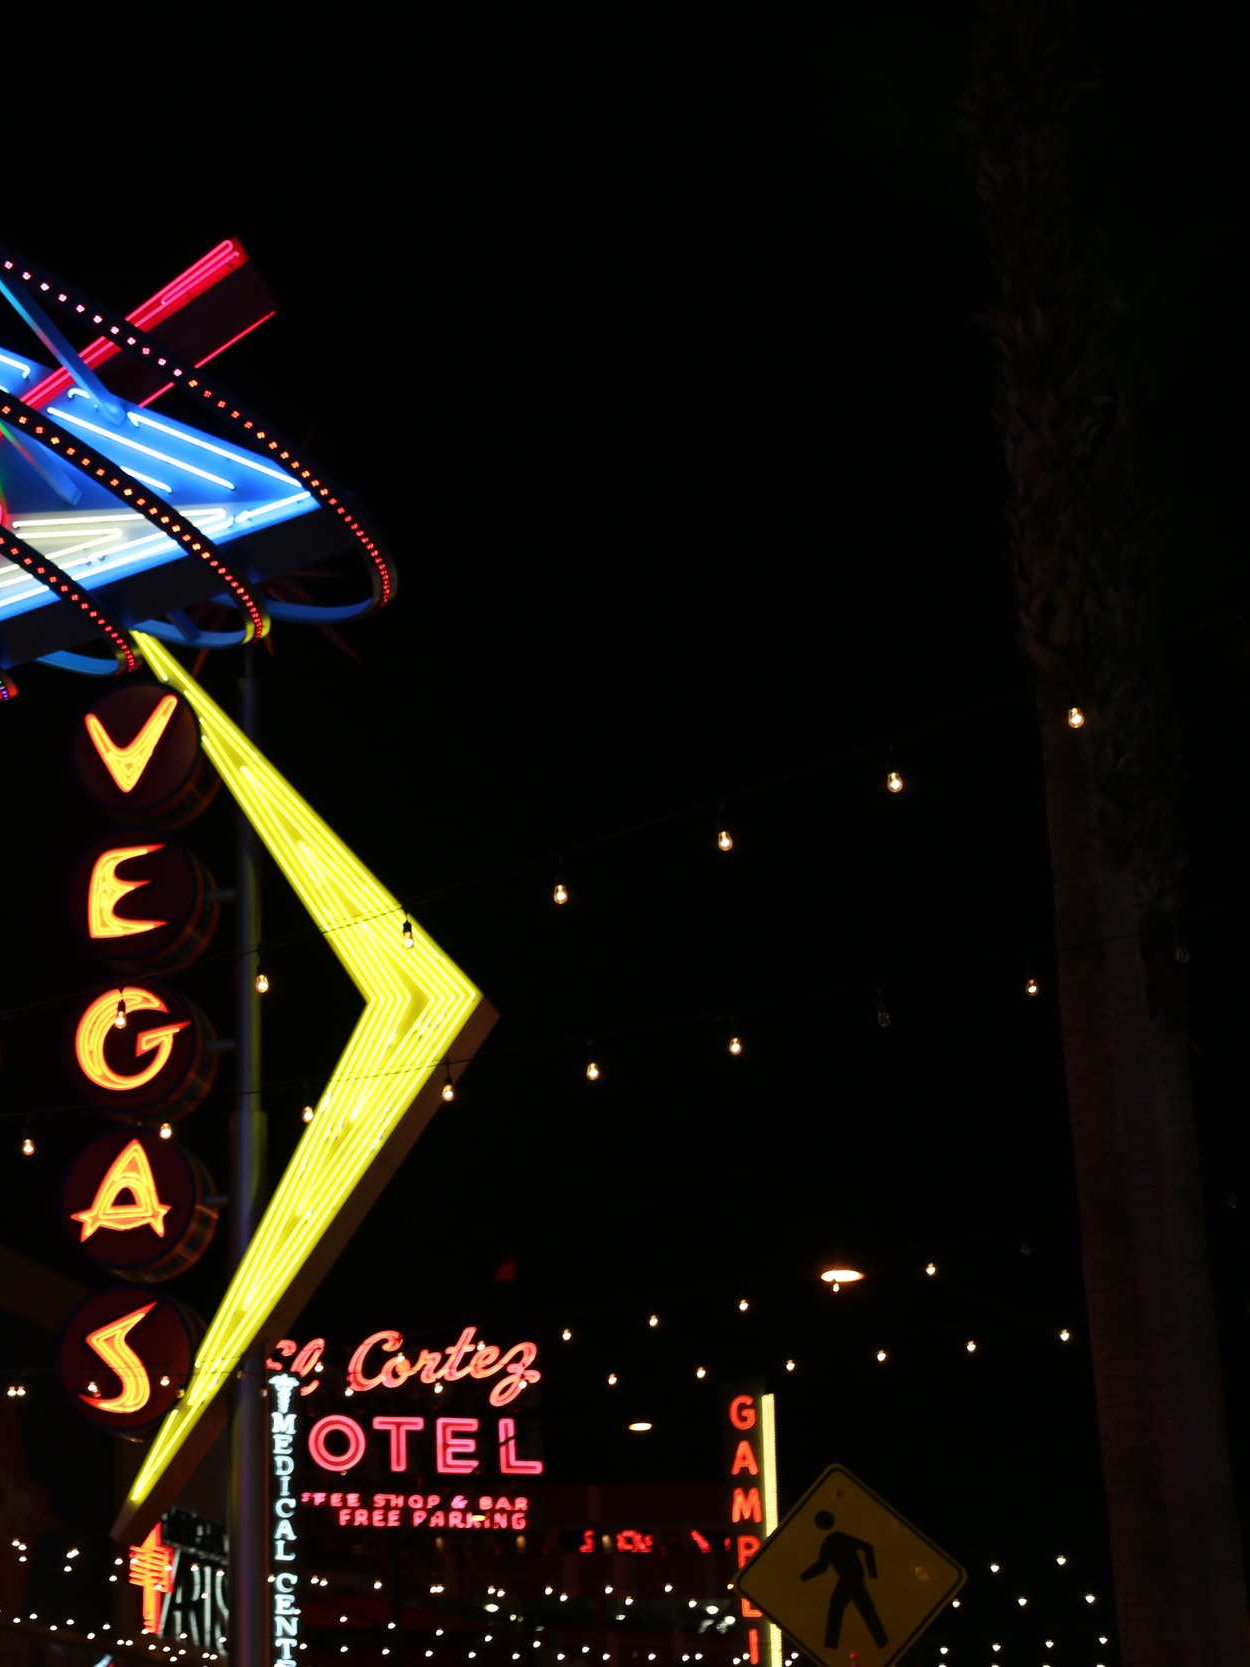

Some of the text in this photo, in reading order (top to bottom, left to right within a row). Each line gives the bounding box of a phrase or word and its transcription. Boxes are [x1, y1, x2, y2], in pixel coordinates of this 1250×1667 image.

[70, 693, 192, 1414] VEGAS
[346, 1326, 542, 1407] Cortez
[307, 1414, 544, 1475] OTEL
[339, 1508, 527, 1530] FREE PARKING
[373, 1493, 441, 1508] SHOP
[451, 1494, 469, 1509] &
[479, 1496, 528, 1511] BAR
[271, 1411, 300, 1667] MEDICAL CENT
